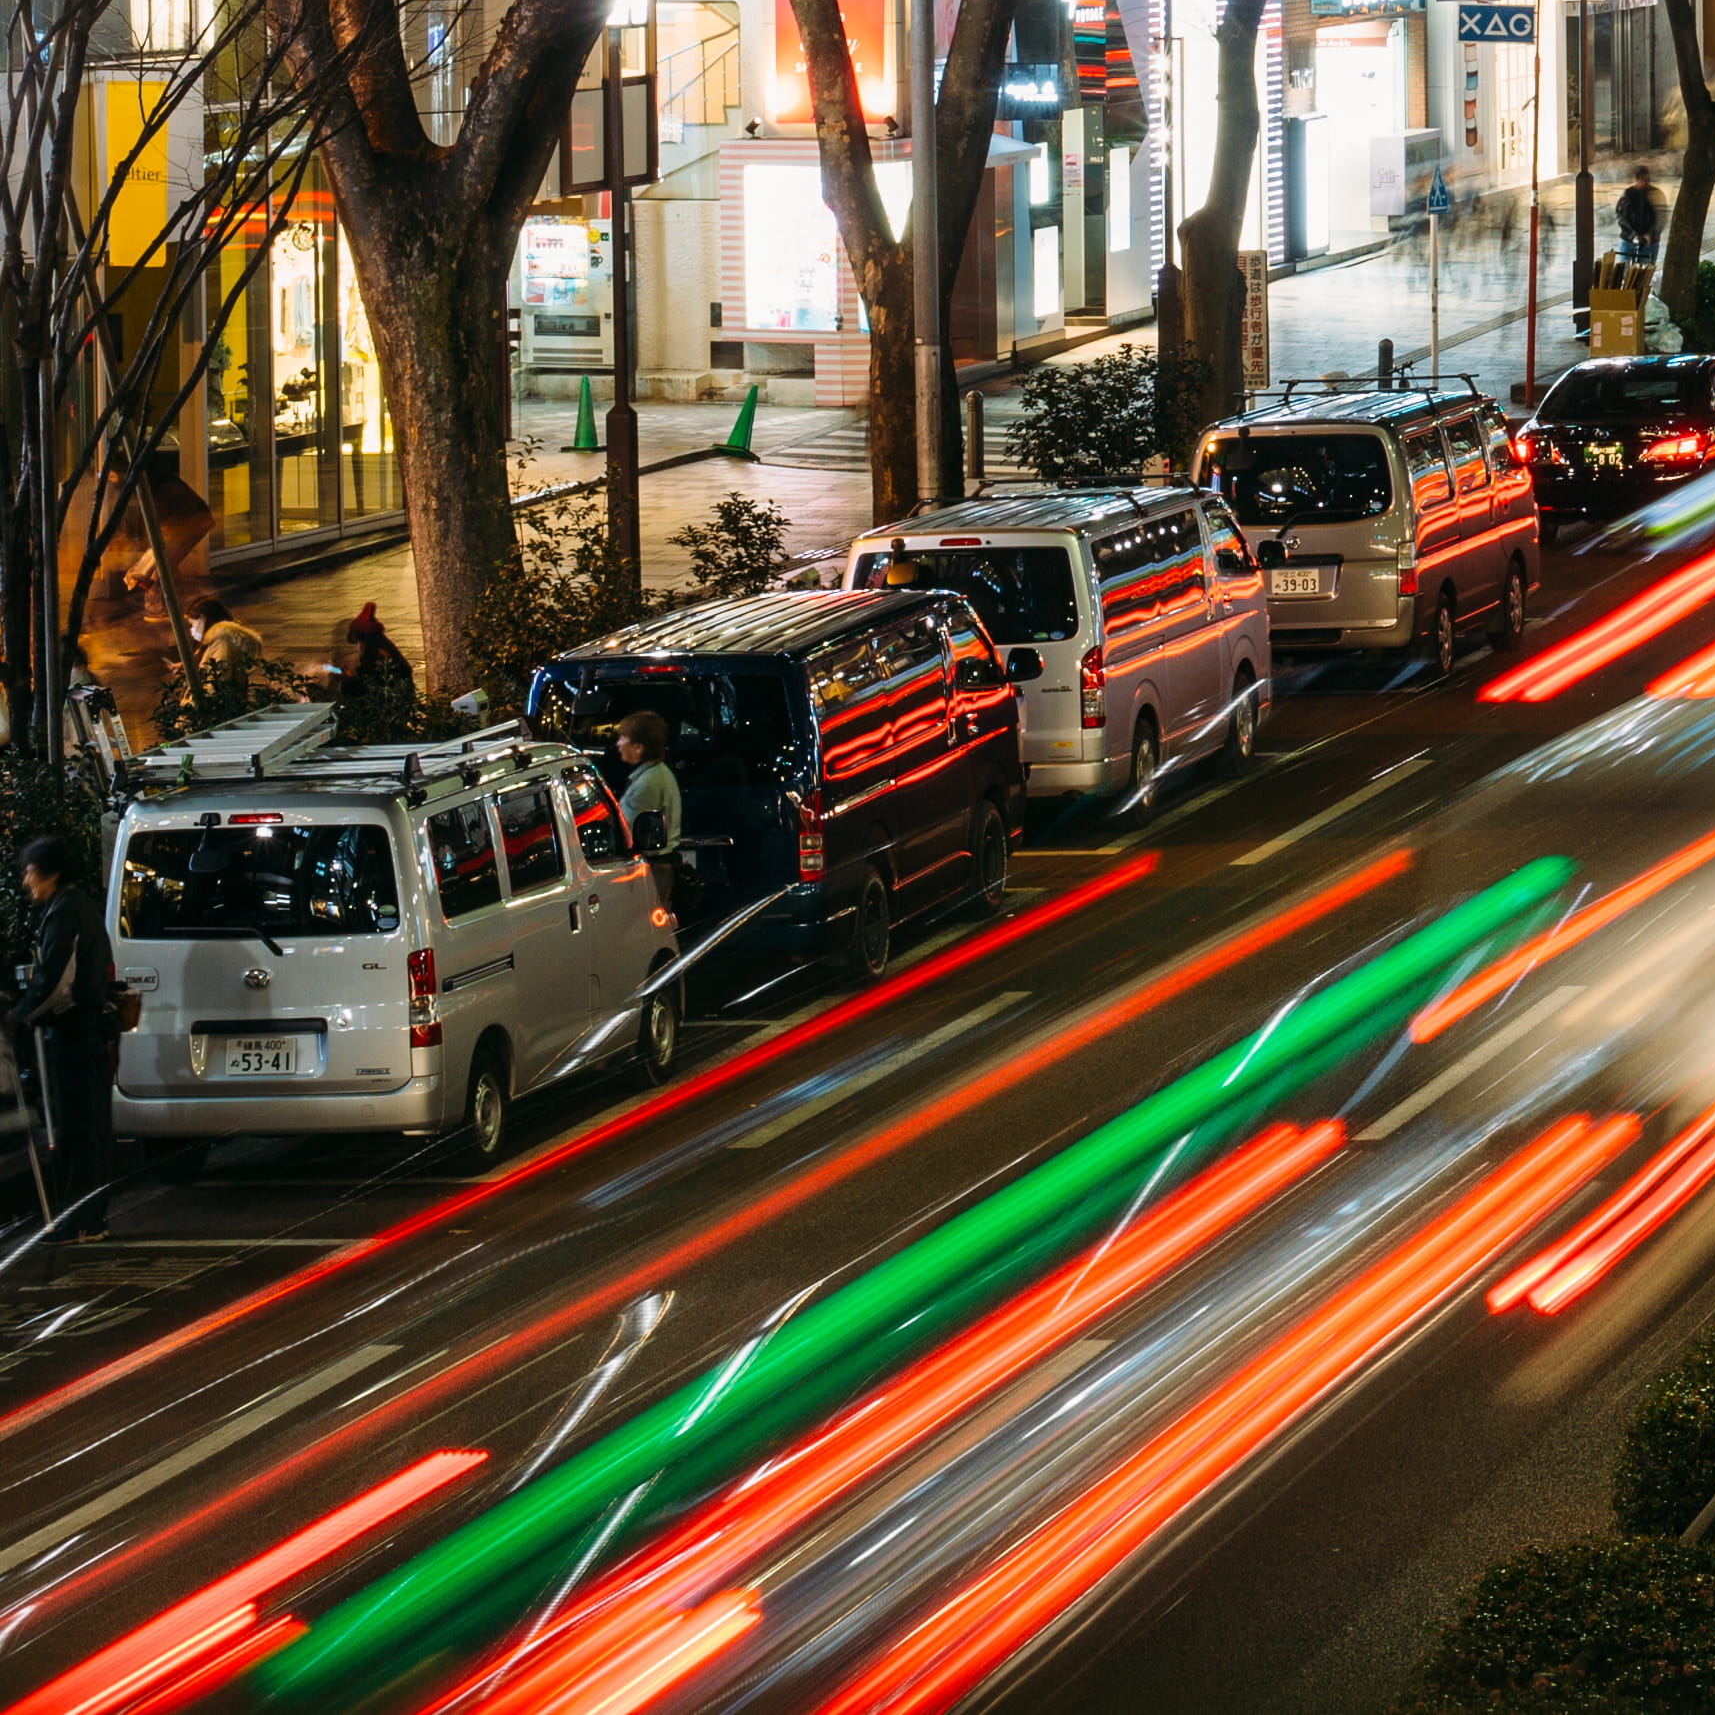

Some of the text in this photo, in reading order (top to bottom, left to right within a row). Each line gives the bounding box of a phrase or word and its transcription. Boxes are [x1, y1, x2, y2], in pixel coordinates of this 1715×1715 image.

[1249, 255, 1265, 373] 歩道は歩行者が優先
[1282, 578, 1317, 592] 39-03
[242, 1052, 290, 1072] 53-41
